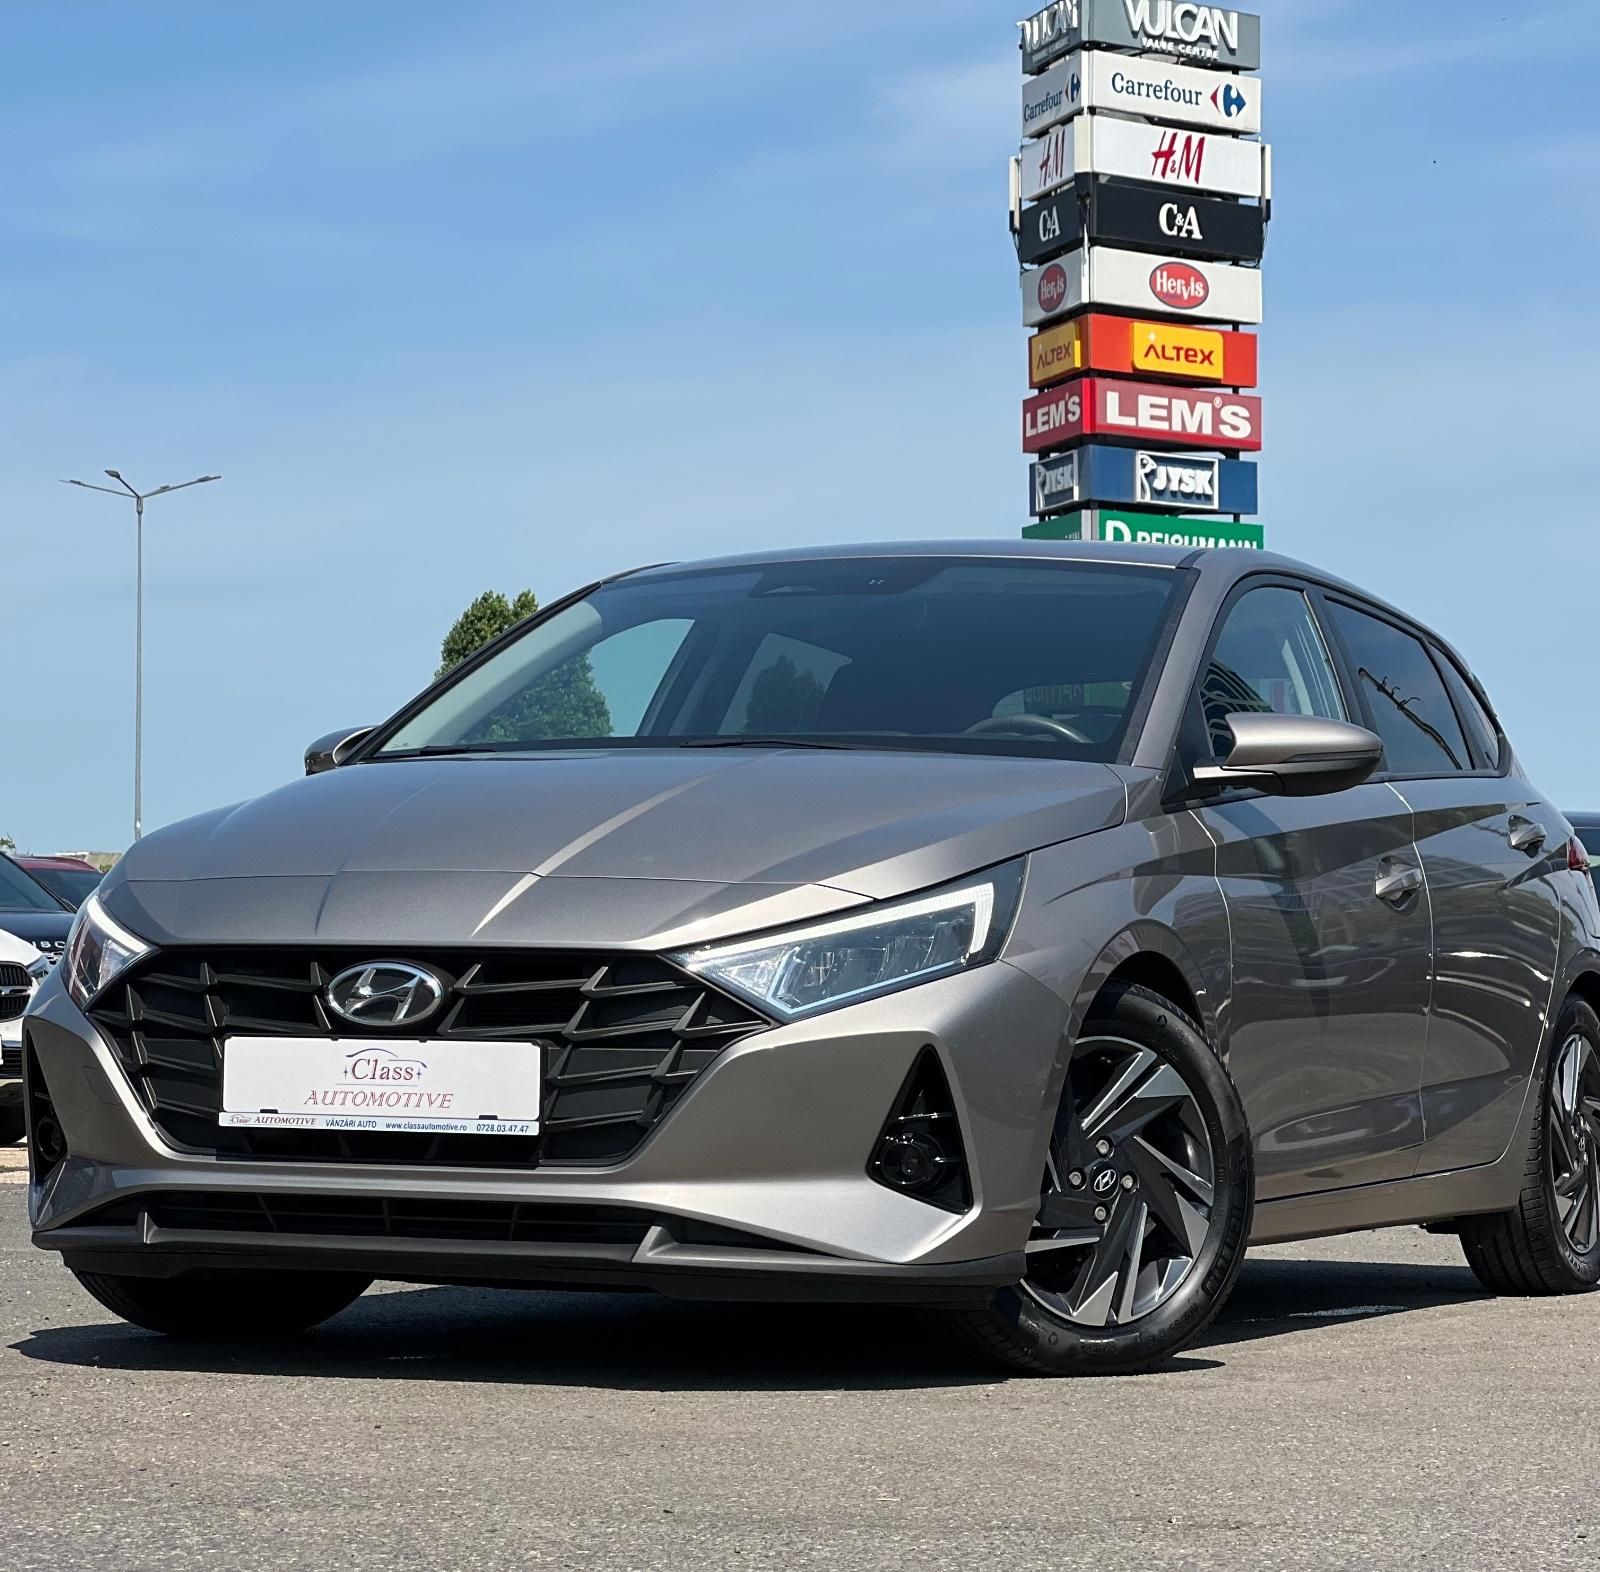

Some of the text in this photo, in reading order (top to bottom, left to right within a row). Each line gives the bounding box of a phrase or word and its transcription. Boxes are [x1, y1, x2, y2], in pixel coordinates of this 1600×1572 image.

[1122, 0, 1238, 50] VULCAN
[1142, 37, 1219, 59] VALUE CENTRE
[1111, 72, 1202, 106] Carrefour
[1023, 90, 1062, 122] Carrefour
[1039, 128, 1065, 187] H&M
[1151, 130, 1205, 184] H&M
[1039, 205, 1061, 242] C&A
[1159, 202, 1203, 240] C&A
[1040, 273, 1065, 301] Hervis
[1156, 269, 1205, 300] Hervis
[1044, 463, 1073, 494] JYSK
[1153, 466, 1213, 495] JYSK
[351, 1058, 414, 1081] Class
[304, 1089, 453, 1110] AUTOMOTIVE
[254, 1116, 316, 1126] AUTOMOTIVE
[357, 1119, 377, 1129] AUTO
[385, 1120, 468, 1132] www.classautomotive.ro
[476, 1123, 529, 1133] 0728.03.47.47
